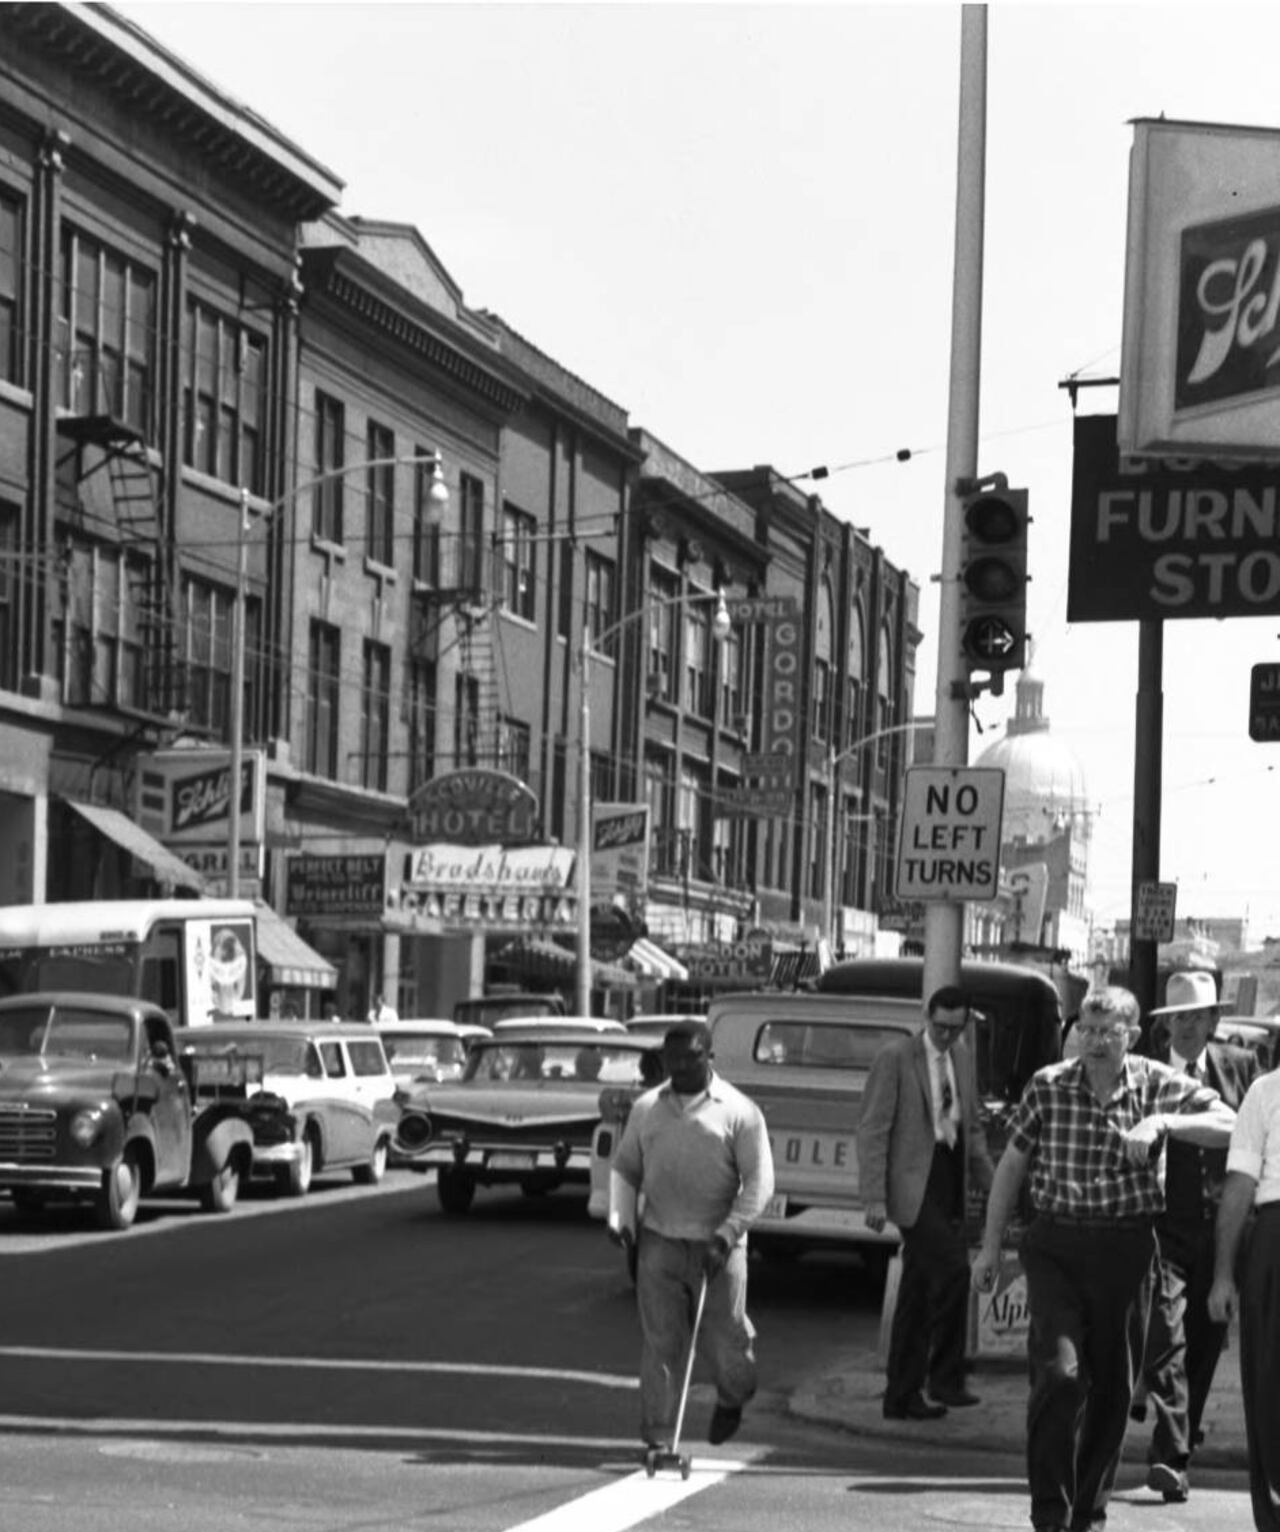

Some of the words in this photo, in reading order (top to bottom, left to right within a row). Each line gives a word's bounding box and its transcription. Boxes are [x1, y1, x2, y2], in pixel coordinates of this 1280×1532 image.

[926, 784, 979, 816] NO
[418, 809, 527, 836] HOTEL
[913, 824, 987, 851] LEFT
[184, 853, 257, 872] GRIL
[904, 858, 992, 886] TURNS
[402, 893, 577, 922] CAFETERIA
